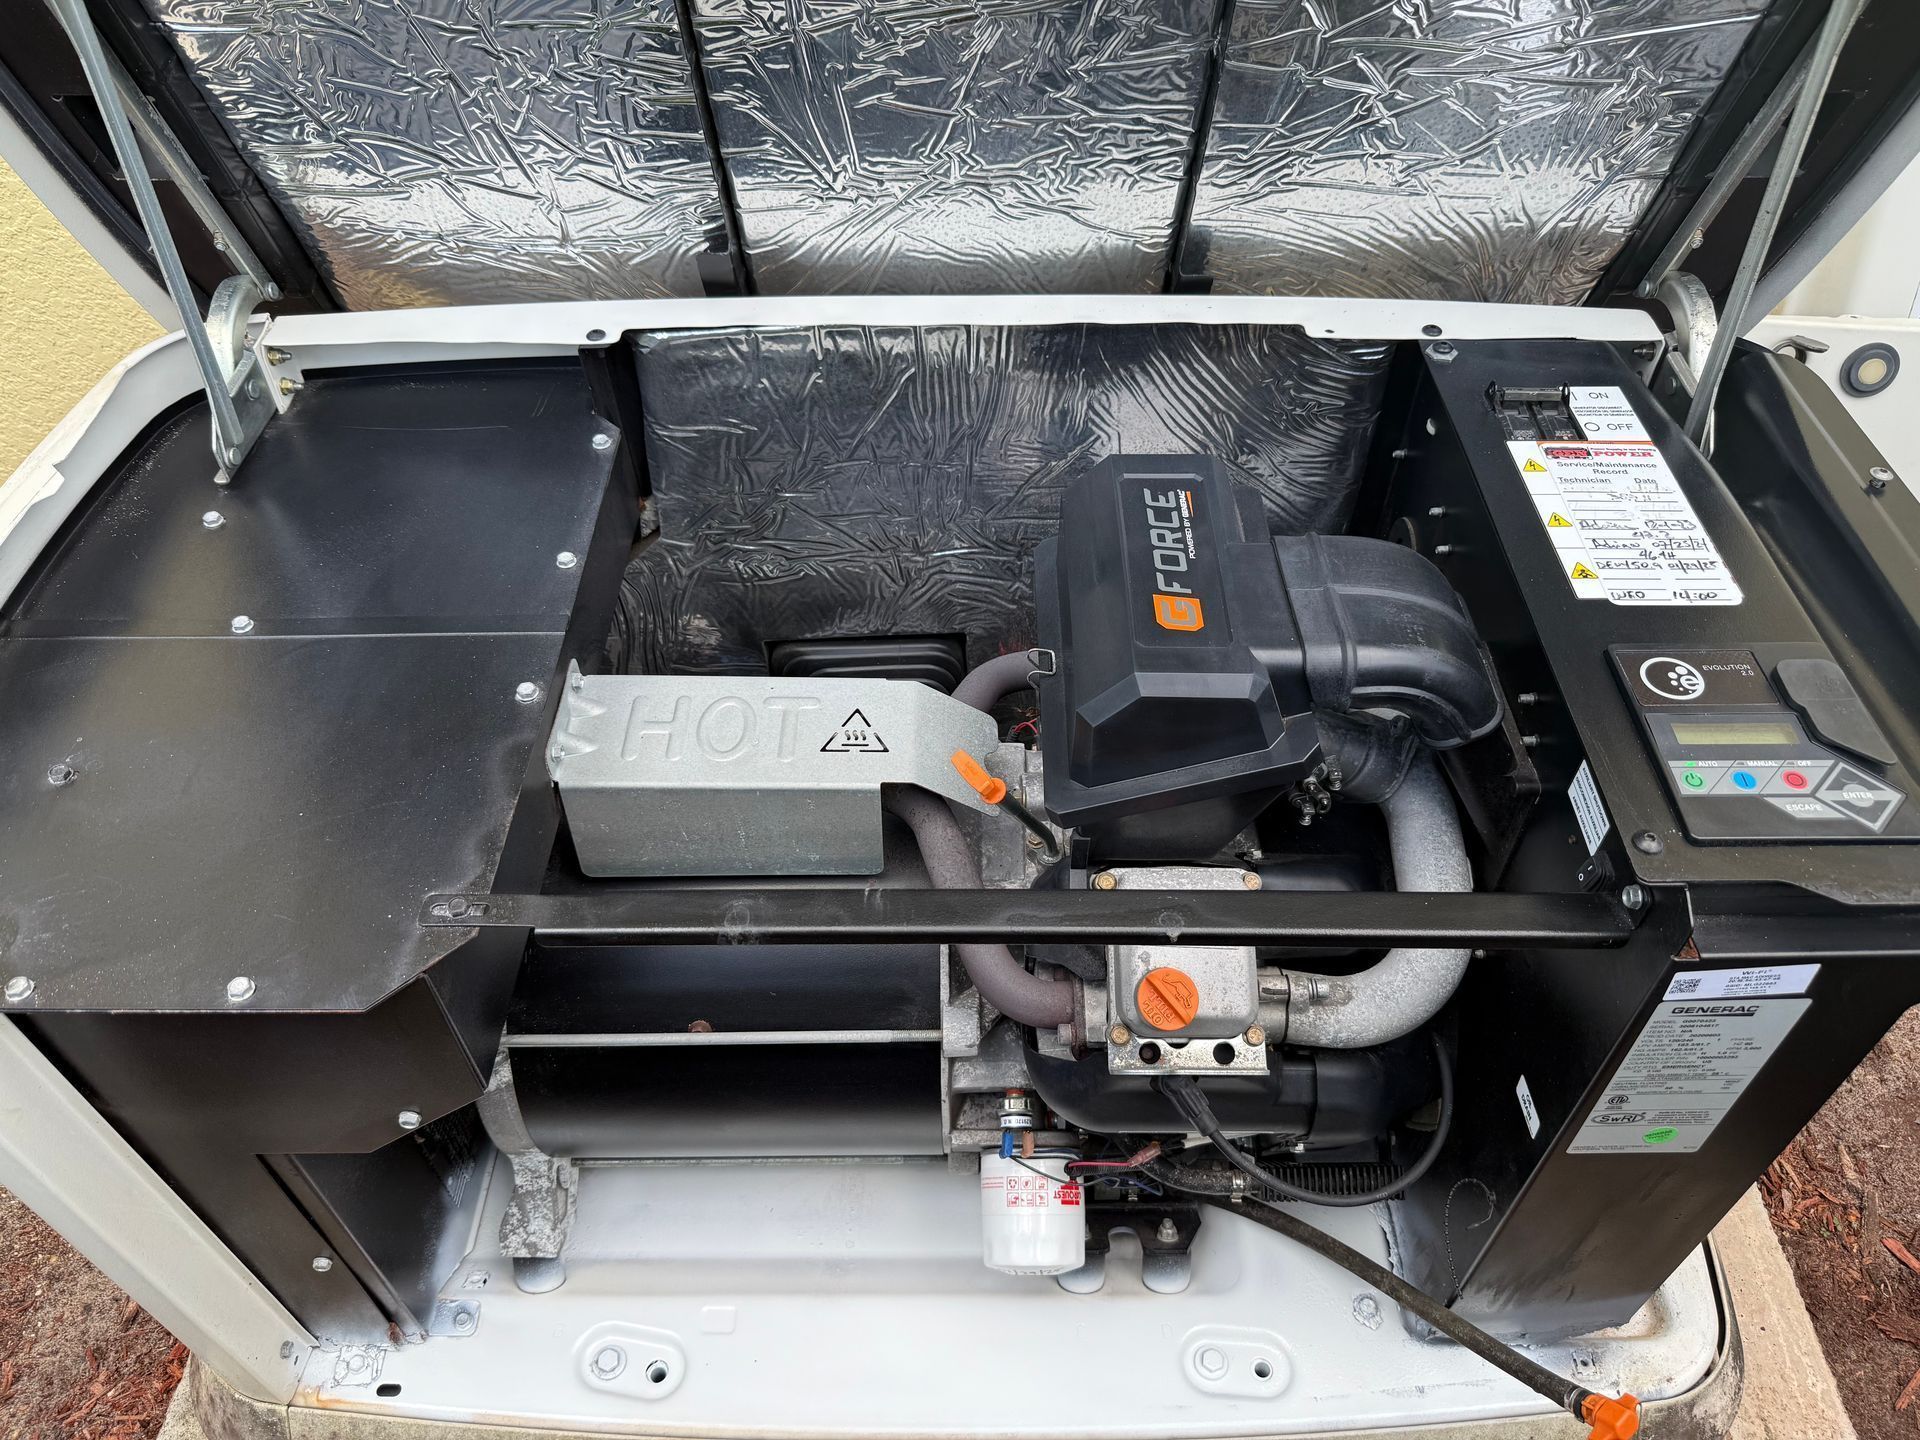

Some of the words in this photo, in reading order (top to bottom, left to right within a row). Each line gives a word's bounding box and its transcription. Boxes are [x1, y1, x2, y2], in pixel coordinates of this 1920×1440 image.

[1177, 489, 1189, 518] GENERAC
[1184, 518, 1191, 527] BY
[1185, 528, 1196, 559] POWERED
[620, 696, 820, 762] HOT
[1142, 999, 1165, 1026] OIL
[1672, 1006, 1760, 1014] GENERAC
